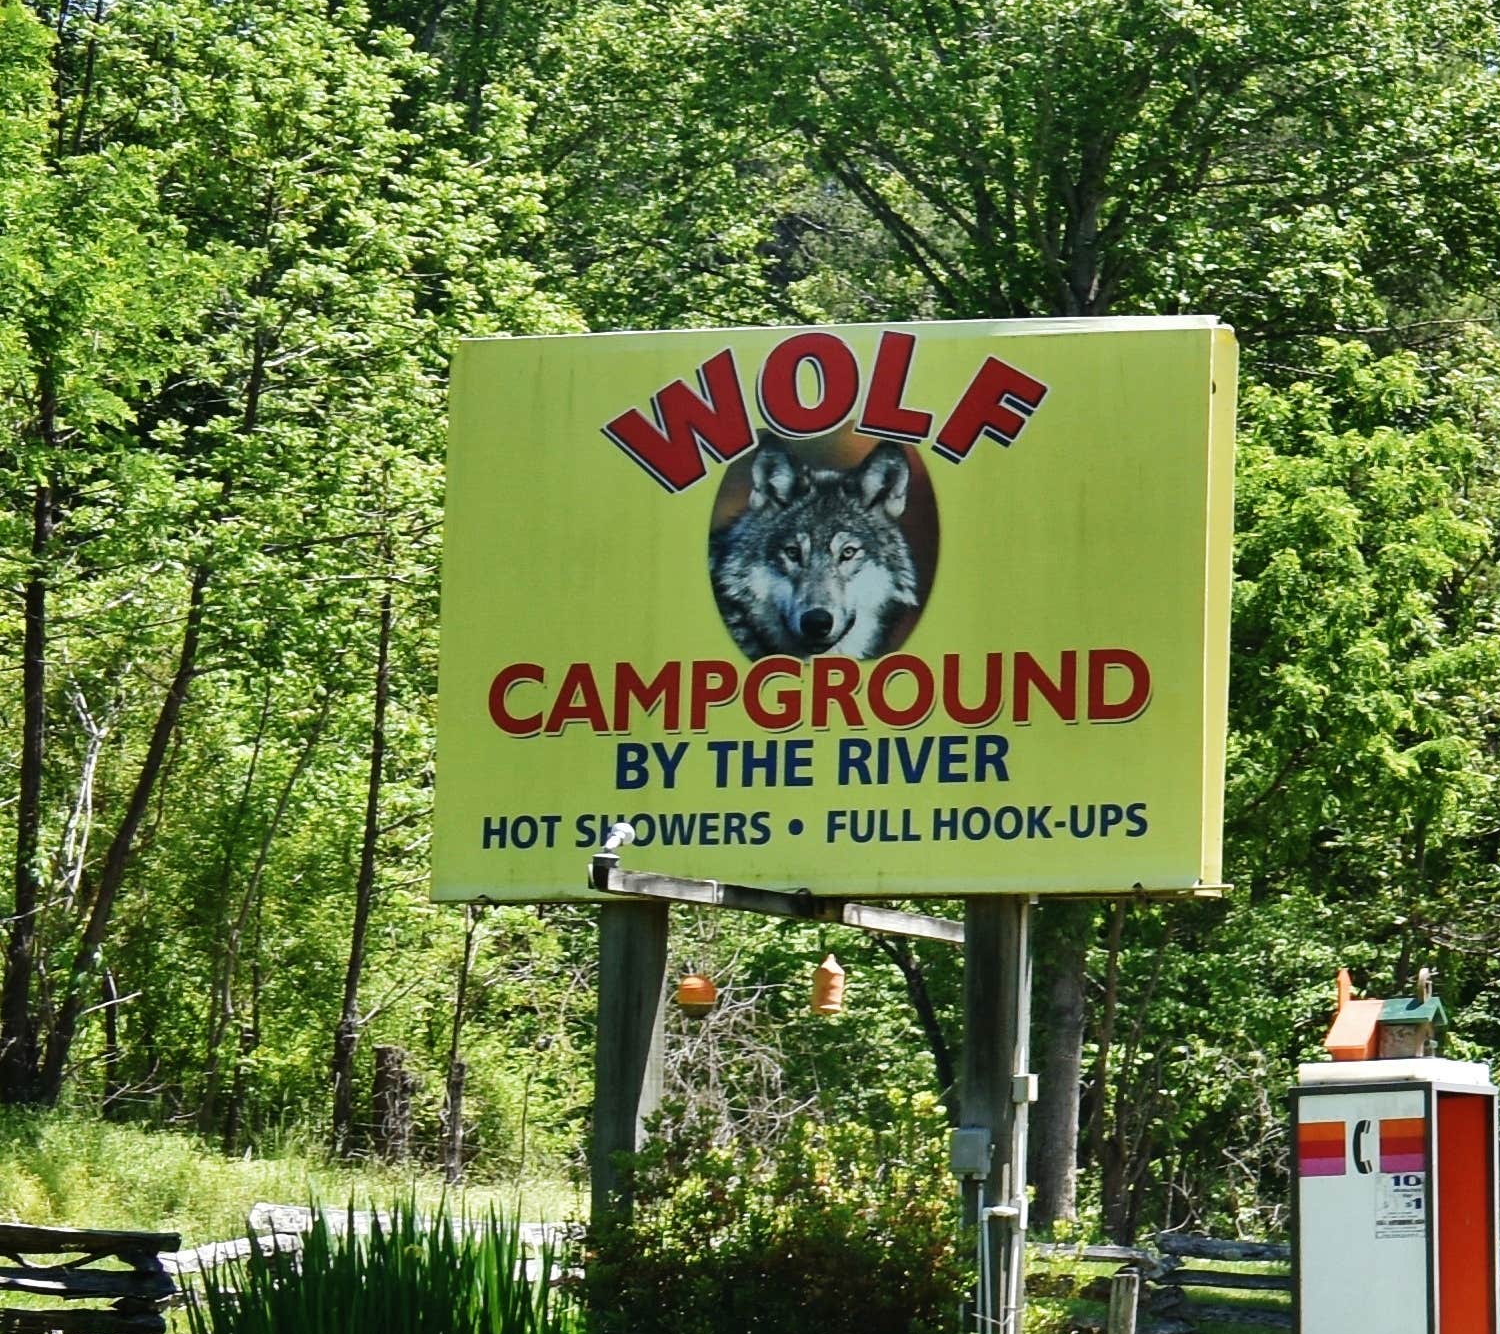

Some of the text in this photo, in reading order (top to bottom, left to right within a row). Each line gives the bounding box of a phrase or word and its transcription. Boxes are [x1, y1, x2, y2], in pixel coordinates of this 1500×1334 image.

[602, 330, 1048, 494] WOLF
[488, 649, 1152, 737] CAMPGROUND
[615, 734, 1010, 791] BY THE RIVER
[482, 803, 1148, 849] HOT SHOWERS FULL HOOK-UPS
